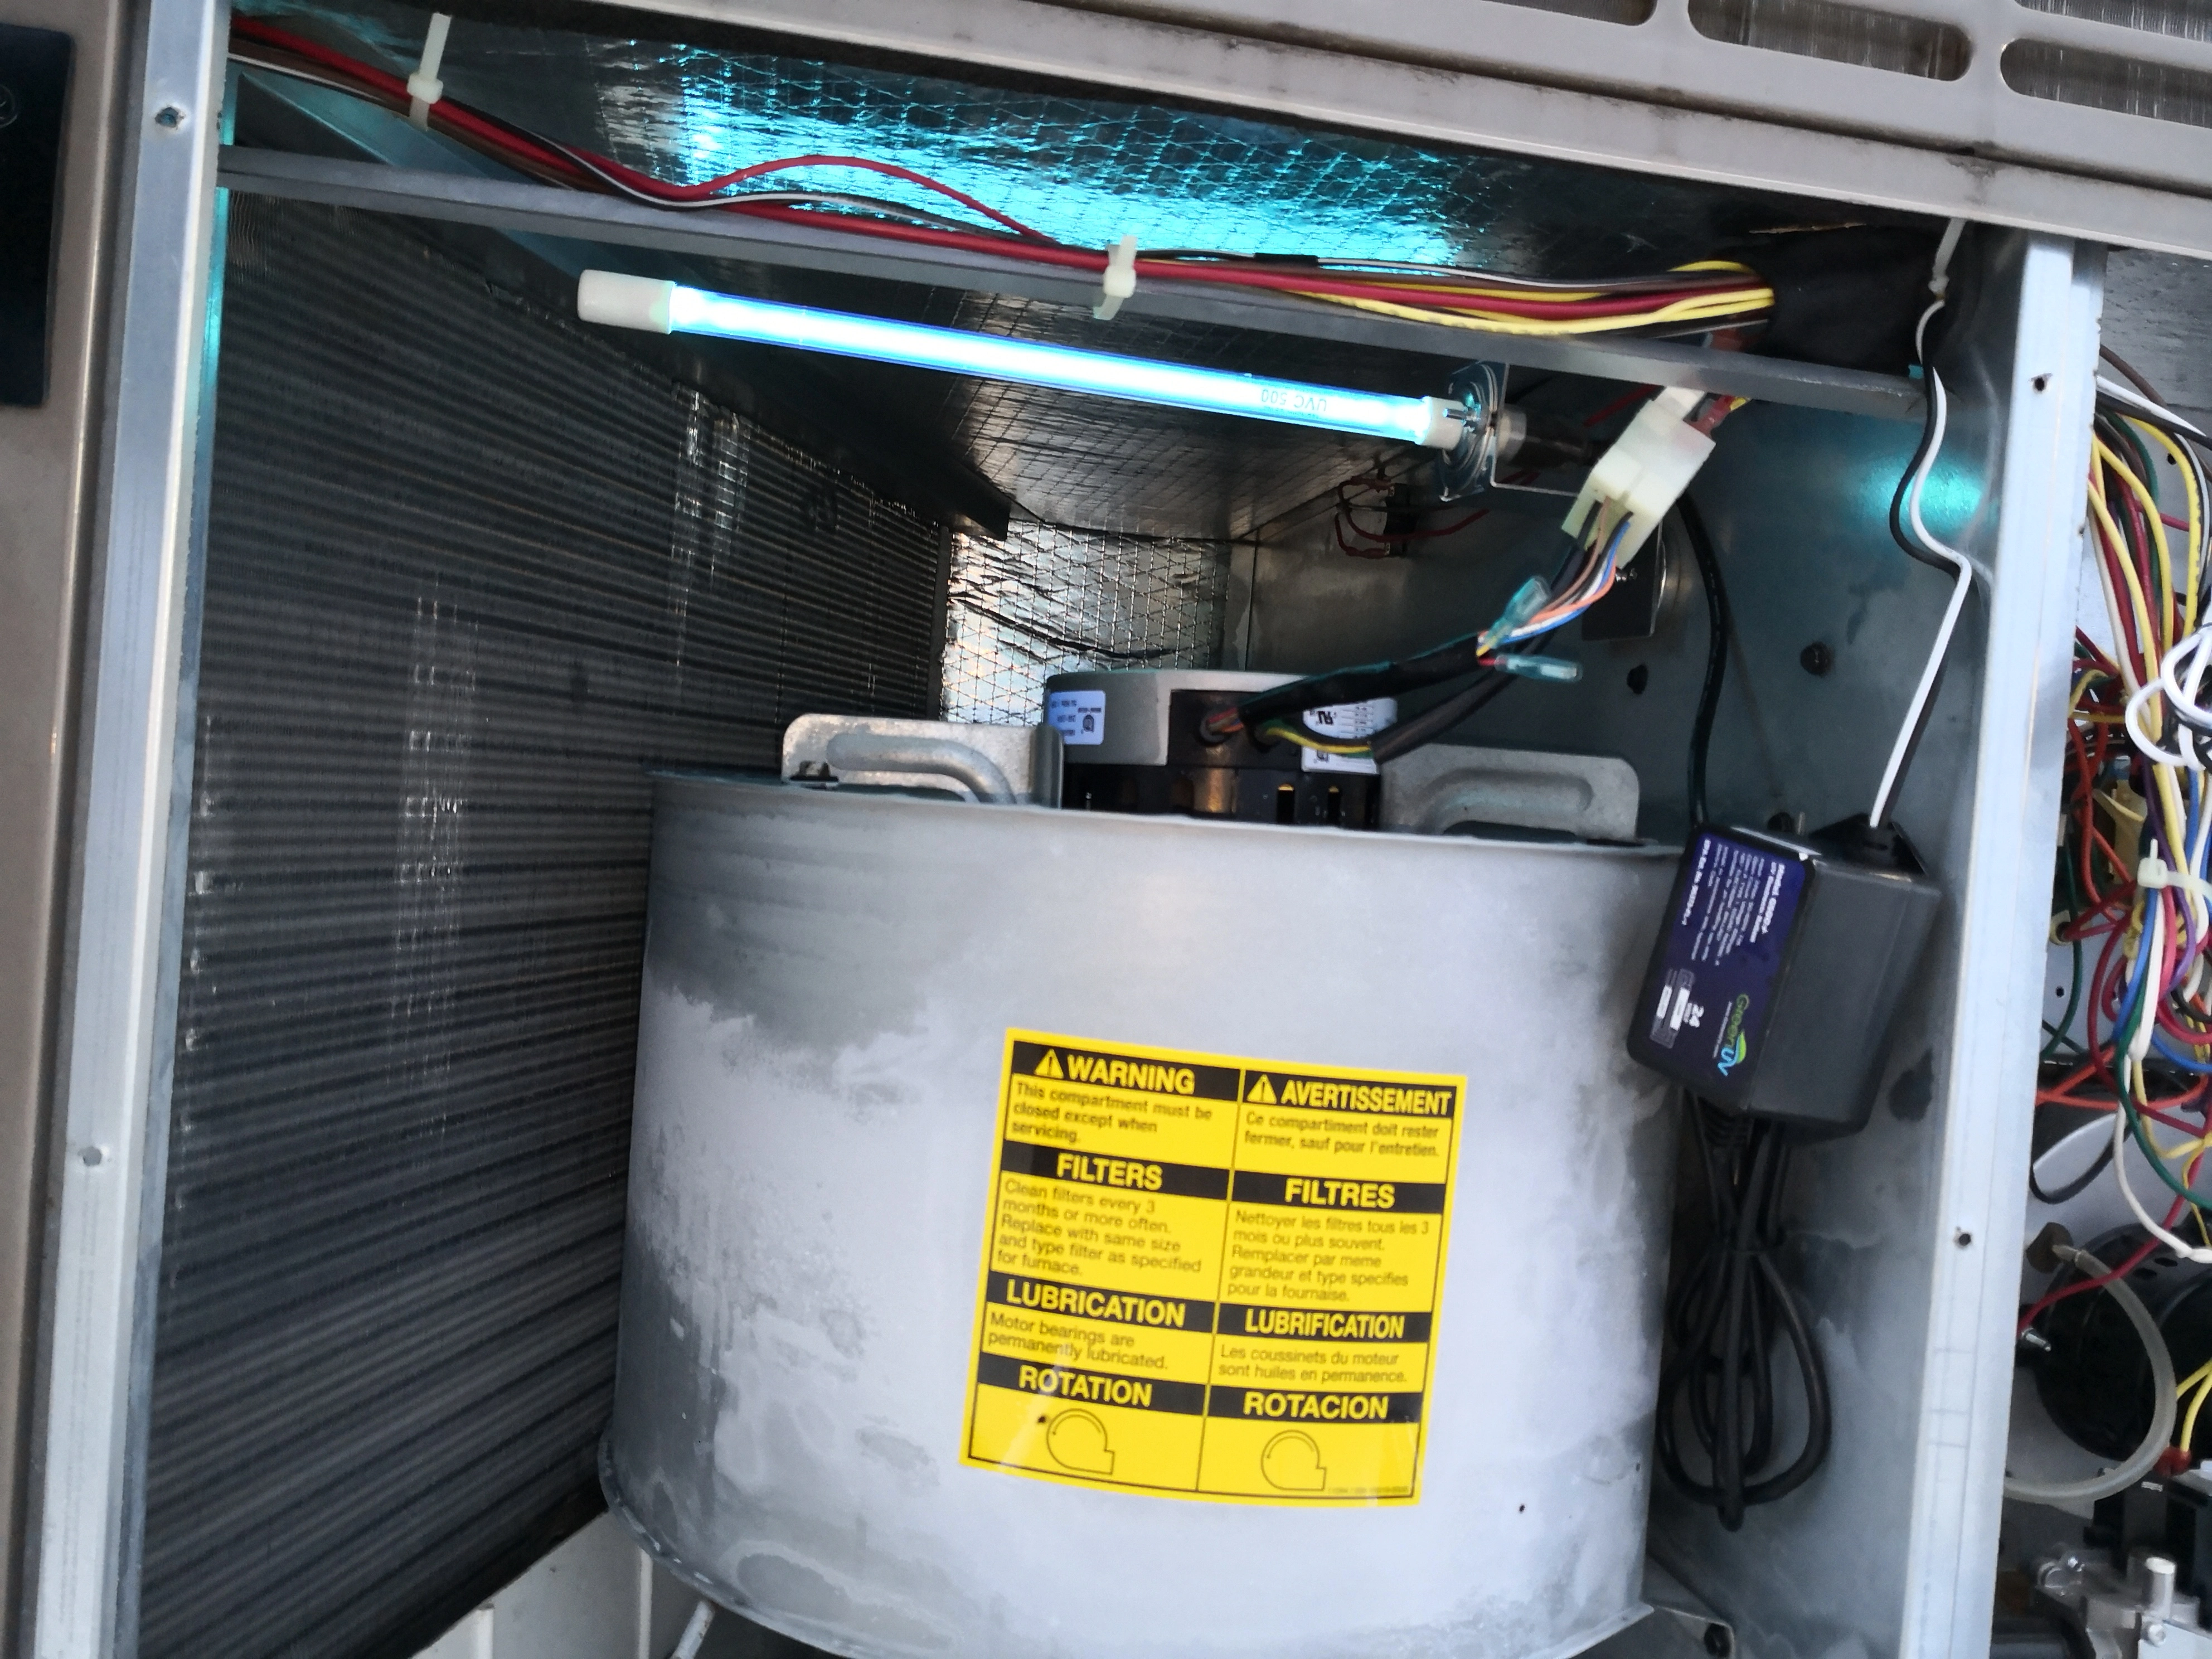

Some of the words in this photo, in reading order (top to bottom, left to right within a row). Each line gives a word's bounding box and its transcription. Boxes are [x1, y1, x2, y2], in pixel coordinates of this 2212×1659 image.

[1262, 389, 1287, 405] 500
[1294, 395, 1327, 411] UVC
[1067, 1054, 1195, 1094] WARNING
[1016, 1082, 1045, 1100] This
[1050, 1087, 1148, 1113] compartment
[1153, 1103, 1190, 1118] must
[1196, 1105, 1211, 1120] be
[1280, 1079, 1452, 1115] AVERTISSEMENT
[1012, 1122, 1080, 1144] servicing.
[1014, 1102, 1059, 1120] closed
[1065, 1109, 1112, 1129] except
[1118, 1114, 1157, 1133] when
[1246, 1110, 1263, 1126] Ce
[1269, 1114, 1367, 1136] compartiment
[1372, 1121, 1398, 1136] doit
[1401, 1124, 1438, 1138] rester
[1301, 1138, 1330, 1151] sauf
[1335, 1141, 1365, 1154] pour
[1057, 1153, 1162, 1191] FILTERS
[1005, 1178, 1047, 1199] Clean
[1053, 1186, 1093, 1205] filters
[1100, 1196, 1141, 1214] every
[1147, 1200, 1155, 1213] 3
[1284, 1177, 1395, 1209] FILTRES
[1003, 1199, 1059, 1219] months
[1064, 1210, 1078, 1221] or
[1084, 1211, 1123, 1226] more
[1129, 1216, 1171, 1234] often.
[1302, 1216, 1320, 1230] les
[1326, 1217, 1361, 1233] filtres
[1368, 1220, 1394, 1233] tous
[1400, 1221, 1417, 1234] les
[1422, 1221, 1429, 1235] 3
[1002, 1214, 1062, 1236] Replace
[1068, 1226, 1098, 1243] with
[1104, 1232, 1146, 1249] same
[1151, 1238, 1181, 1252] size
[1234, 1229, 1267, 1243] mois
[1273, 1233, 1290, 1245] ou
[1295, 1234, 1324, 1249] plus
[1329, 1236, 1385, 1250] souvent.
[997, 1249, 1017, 1264] for
[1022, 1254, 1083, 1276] furnace.
[999, 1233, 1026, 1248] and
[1032, 1239, 1064, 1255] type
[1069, 1243, 1103, 1260] filter
[1109, 1250, 1126, 1264] as
[1131, 1251, 1201, 1273] specified
[1233, 1244, 1309, 1264] Remplacer
[1313, 1254, 1336, 1266] par
[1230, 1265, 1293, 1283] grandeur
[1299, 1269, 1312, 1282] et
[1317, 1270, 1346, 1287] type
[1007, 1279, 1186, 1327] LUBRICATION
[1228, 1283, 1260, 1297] pour
[1265, 1284, 1277, 1297] la
[1283, 1286, 1348, 1302] fournaise.
[990, 1312, 1035, 1333] Motor
[1040, 1320, 1105, 1345] bearings
[1110, 1332, 1134, 1346] are
[1245, 1308, 1405, 1340] LUBRIFICATION
[988, 1331, 1082, 1361] permanently
[1086, 1346, 1168, 1370] lubricated.
[1220, 1344, 1246, 1359] Les
[1251, 1347, 1327, 1365] coussinets
[1331, 1351, 1348, 1365] du
[1353, 1352, 1398, 1365] moteur
[1018, 1365, 1152, 1407] ROTATION
[1219, 1364, 1250, 1377] sont
[1301, 1370, 1317, 1380] en
[1322, 1369, 1406, 1384] permanence.
[1244, 1391, 1389, 1420] ROTACION
